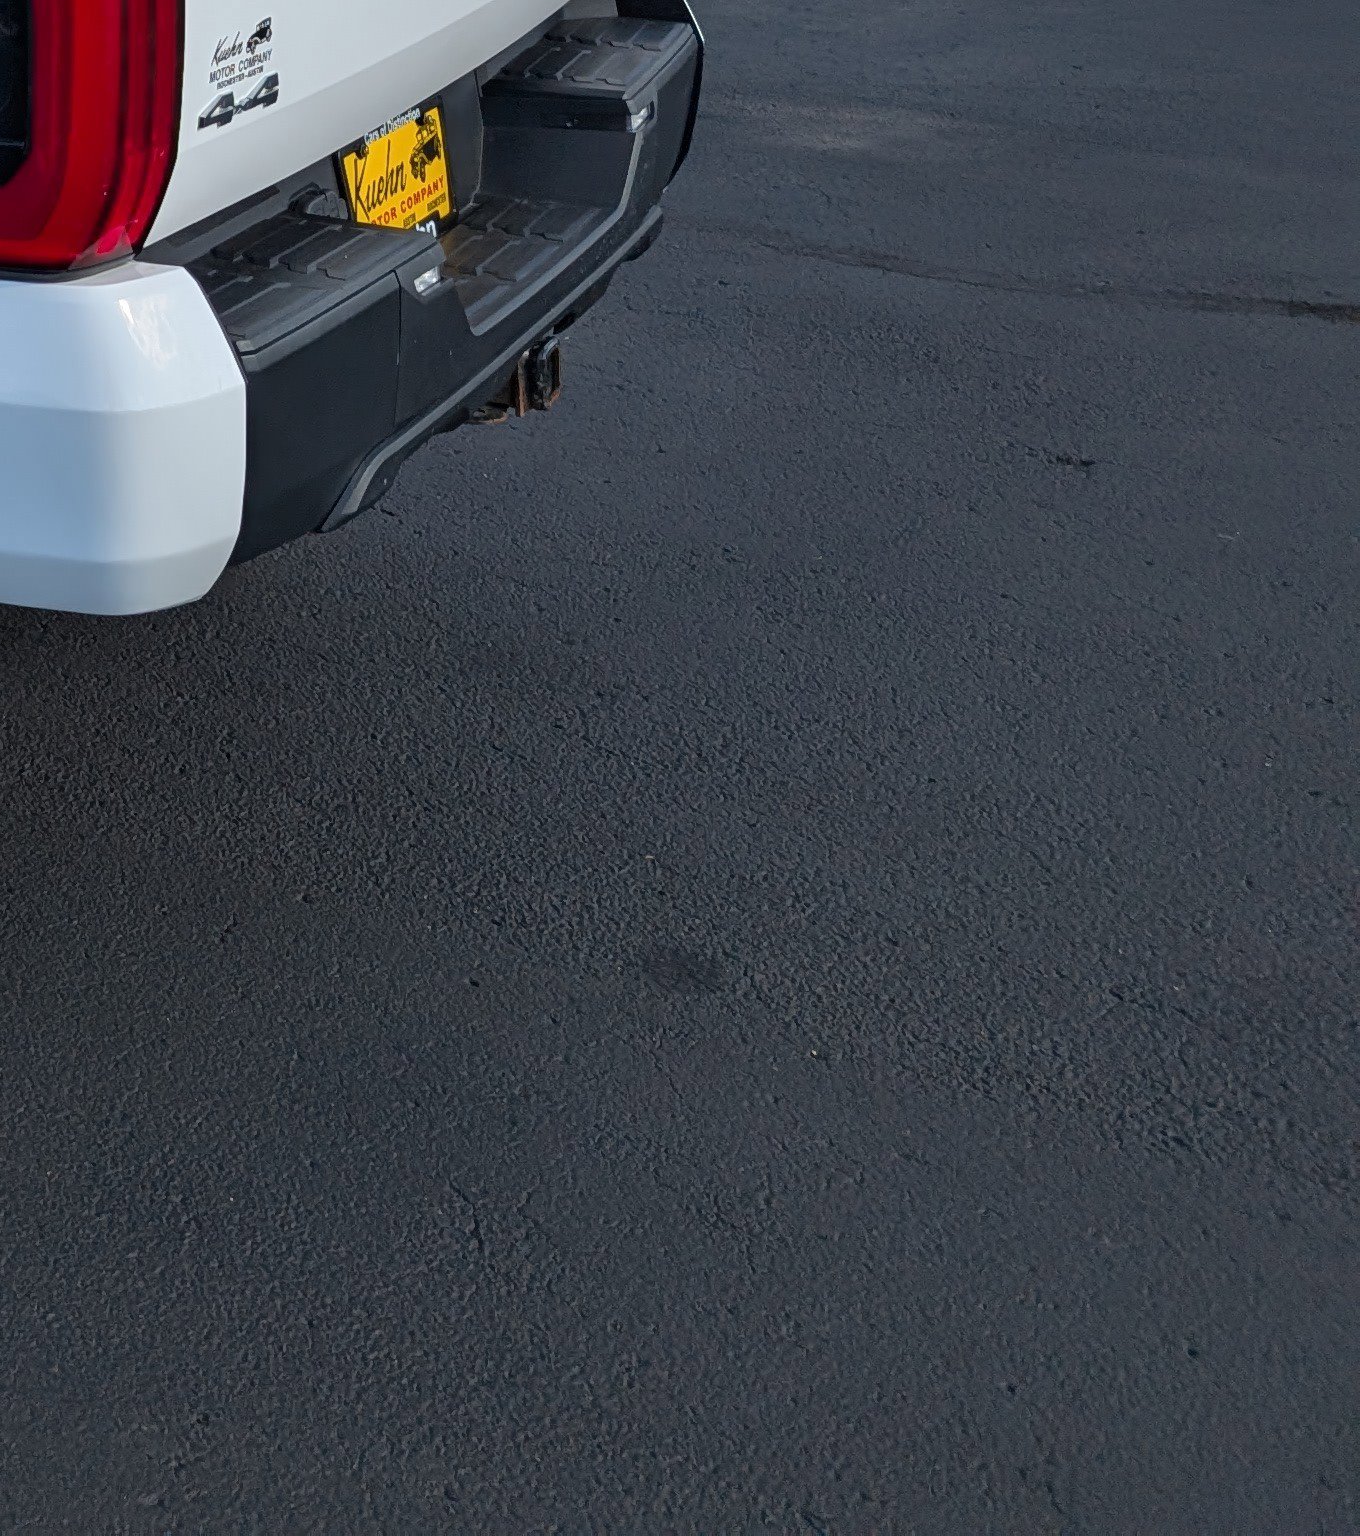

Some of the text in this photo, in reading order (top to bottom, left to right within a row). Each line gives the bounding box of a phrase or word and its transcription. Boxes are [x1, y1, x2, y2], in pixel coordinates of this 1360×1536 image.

[208, 48, 273, 84] MOTOR COMPANY
[210, 30, 244, 67] Kuehn
[353, 138, 408, 222] Kuehn
[371, 206, 398, 226] TOR
[400, 174, 444, 214] COMPANY
